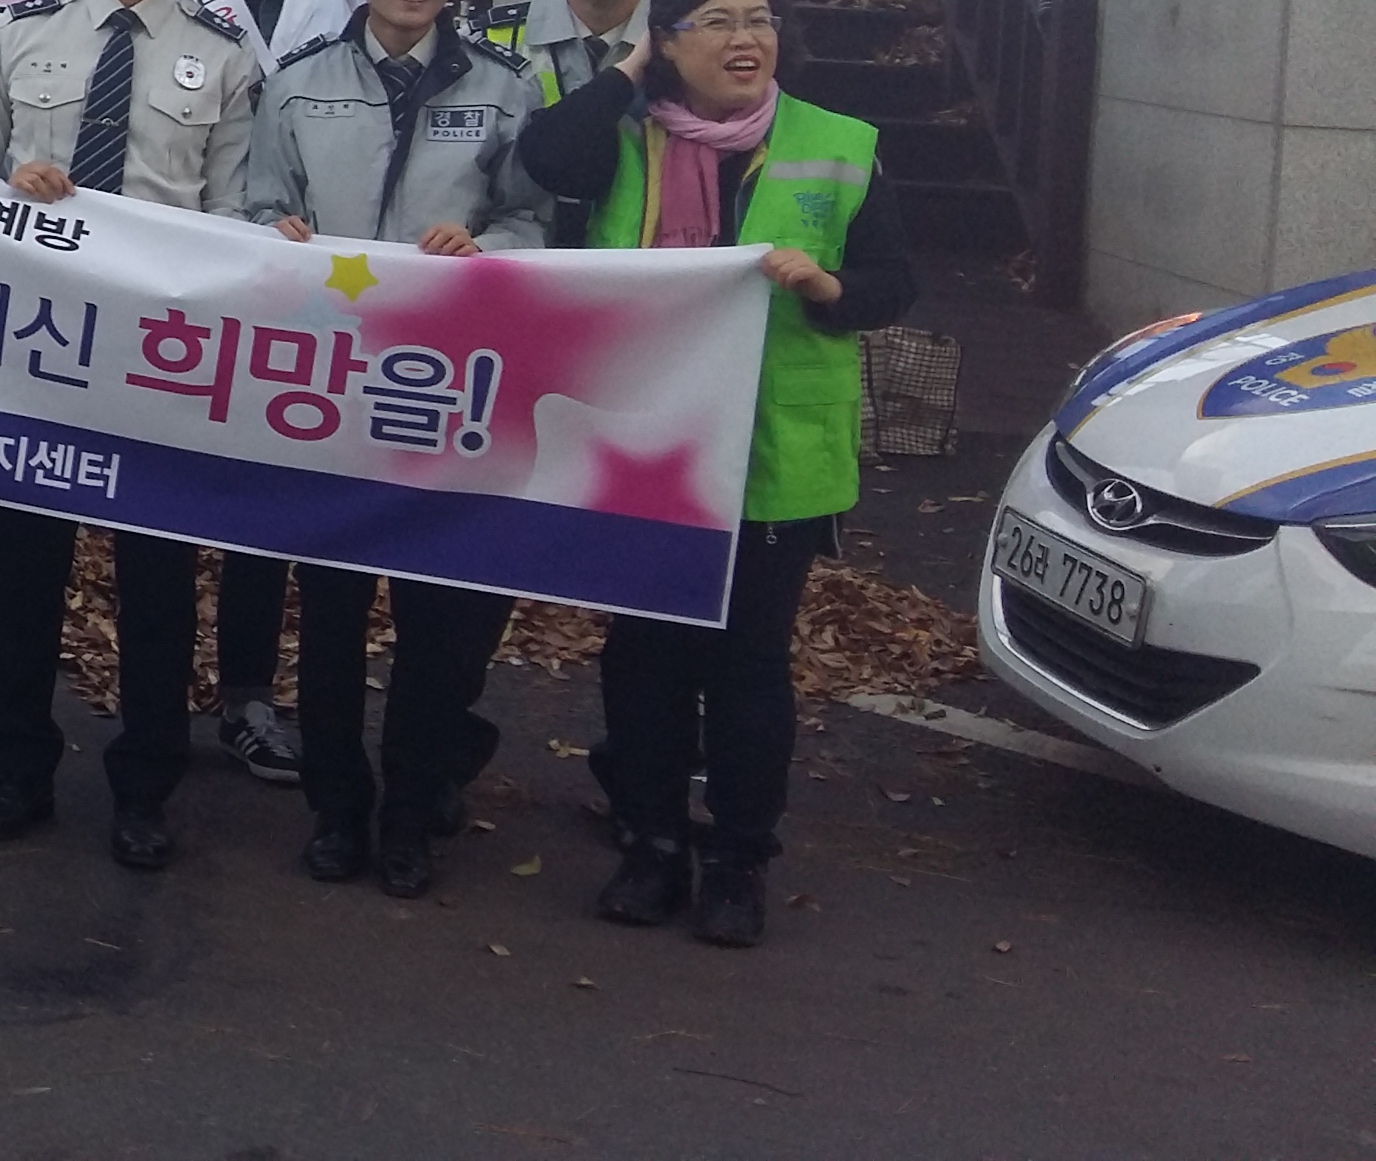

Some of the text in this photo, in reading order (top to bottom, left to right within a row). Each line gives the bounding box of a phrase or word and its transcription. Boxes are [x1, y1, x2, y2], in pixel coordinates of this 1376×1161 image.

[432, 129, 481, 138] POLICE
[125, 306, 504, 458] 희망을!
[1228, 375, 1310, 407] POLICE
[1007, 526, 1125, 626] 26라 7738
